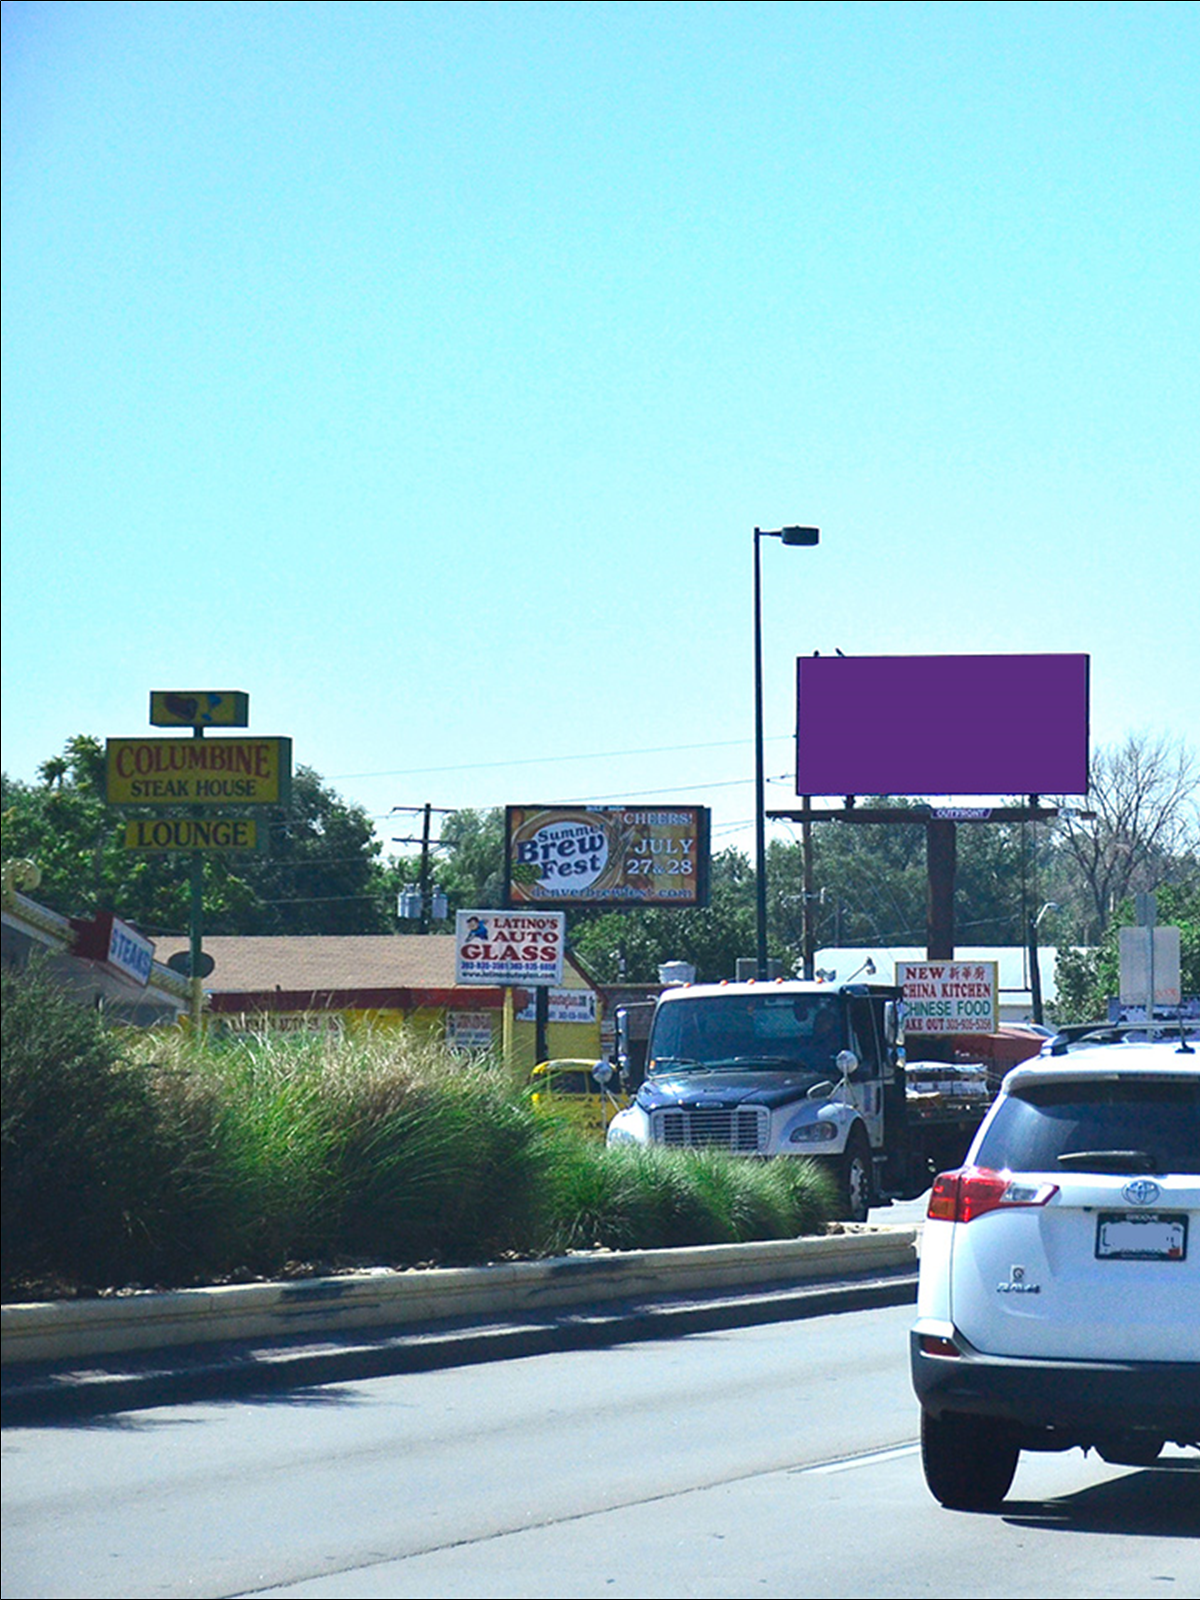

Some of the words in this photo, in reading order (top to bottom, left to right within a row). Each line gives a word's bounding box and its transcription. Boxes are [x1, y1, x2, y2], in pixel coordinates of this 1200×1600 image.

[115, 744, 272, 779] COLUMBINE
[130, 779, 189, 797] STEAK
[195, 779, 258, 797] HOUSE
[624, 813, 694, 826] CHEERS!
[136, 821, 249, 848] LOUNGE
[517, 834, 605, 864] Brew
[635, 839, 695, 854] JULY
[541, 854, 602, 880] Fest
[494, 918, 558, 930] LATINO'S
[493, 931, 559, 944] AUTO
[461, 944, 558, 961] GLASS
[905, 966, 945, 980] NEW
[902, 983, 937, 998] CHINA
[941, 982, 992, 998] KITCHEN
[957, 1001, 991, 1017] FOOD
[904, 1018, 923, 1031] AKE
